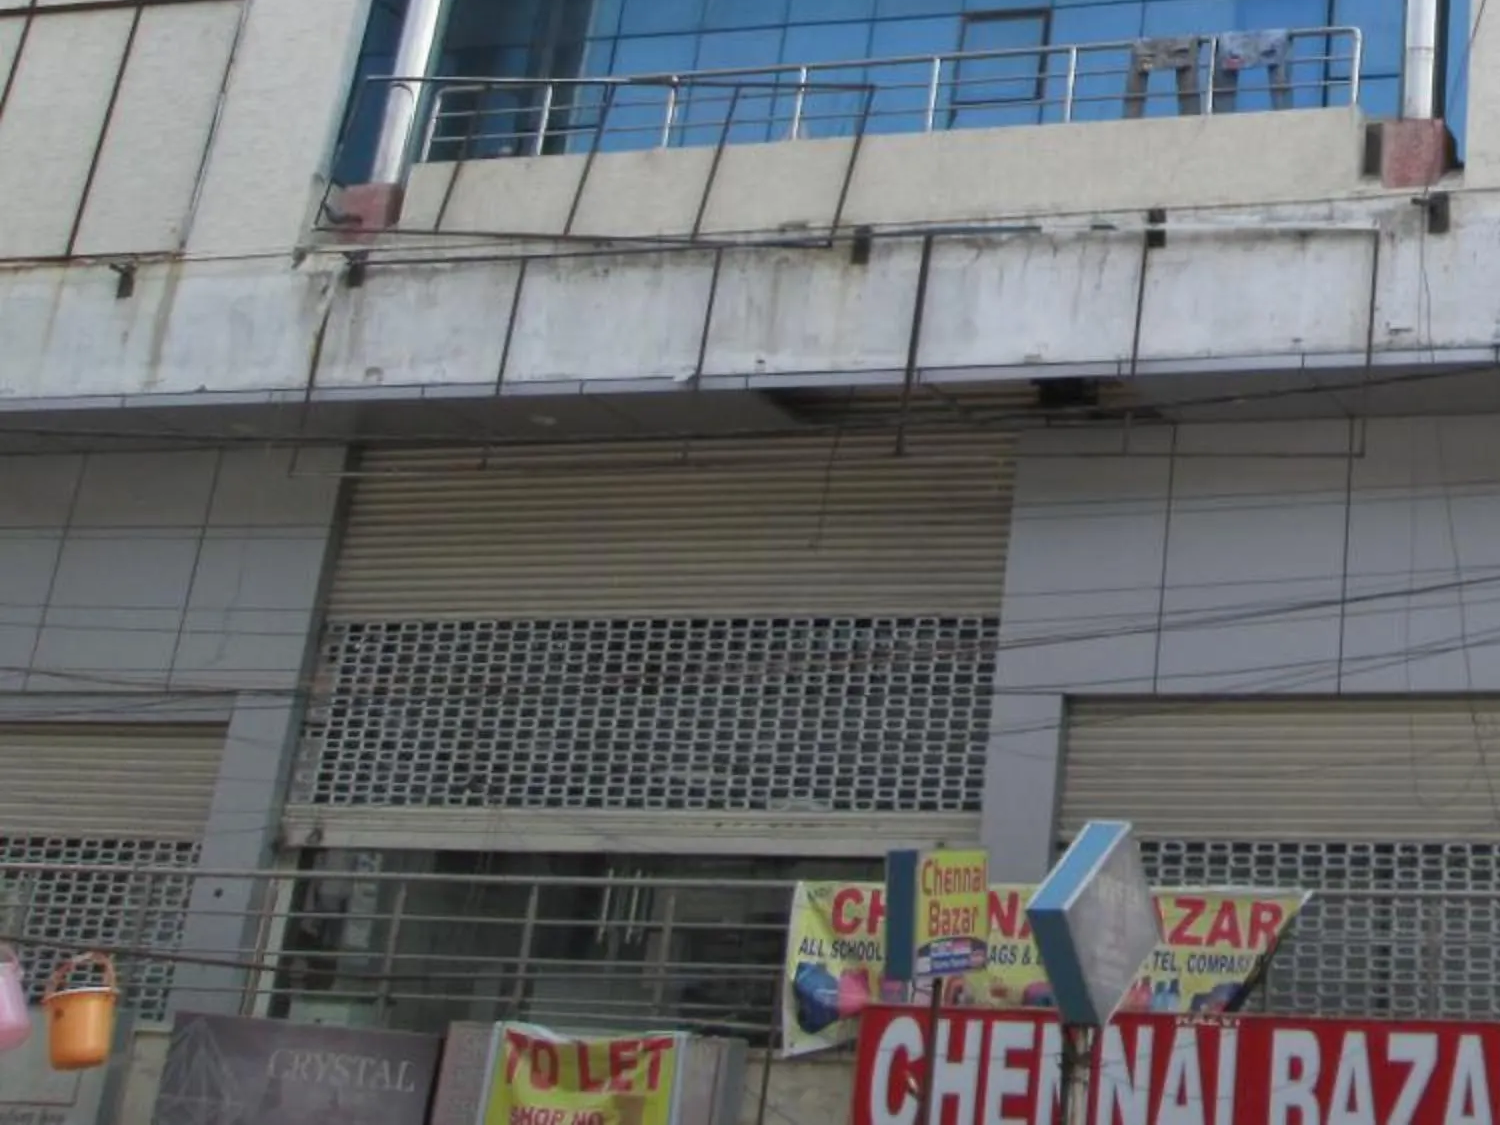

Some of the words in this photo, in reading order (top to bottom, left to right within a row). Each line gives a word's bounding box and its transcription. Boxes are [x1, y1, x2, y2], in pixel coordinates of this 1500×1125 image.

[928, 899, 978, 936] Bazar
[830, 940, 882, 962] SCHOOL
[268, 1048, 416, 1093] CRYSTAL
[505, 1028, 559, 1092] TO
[576, 1036, 675, 1092] LET
